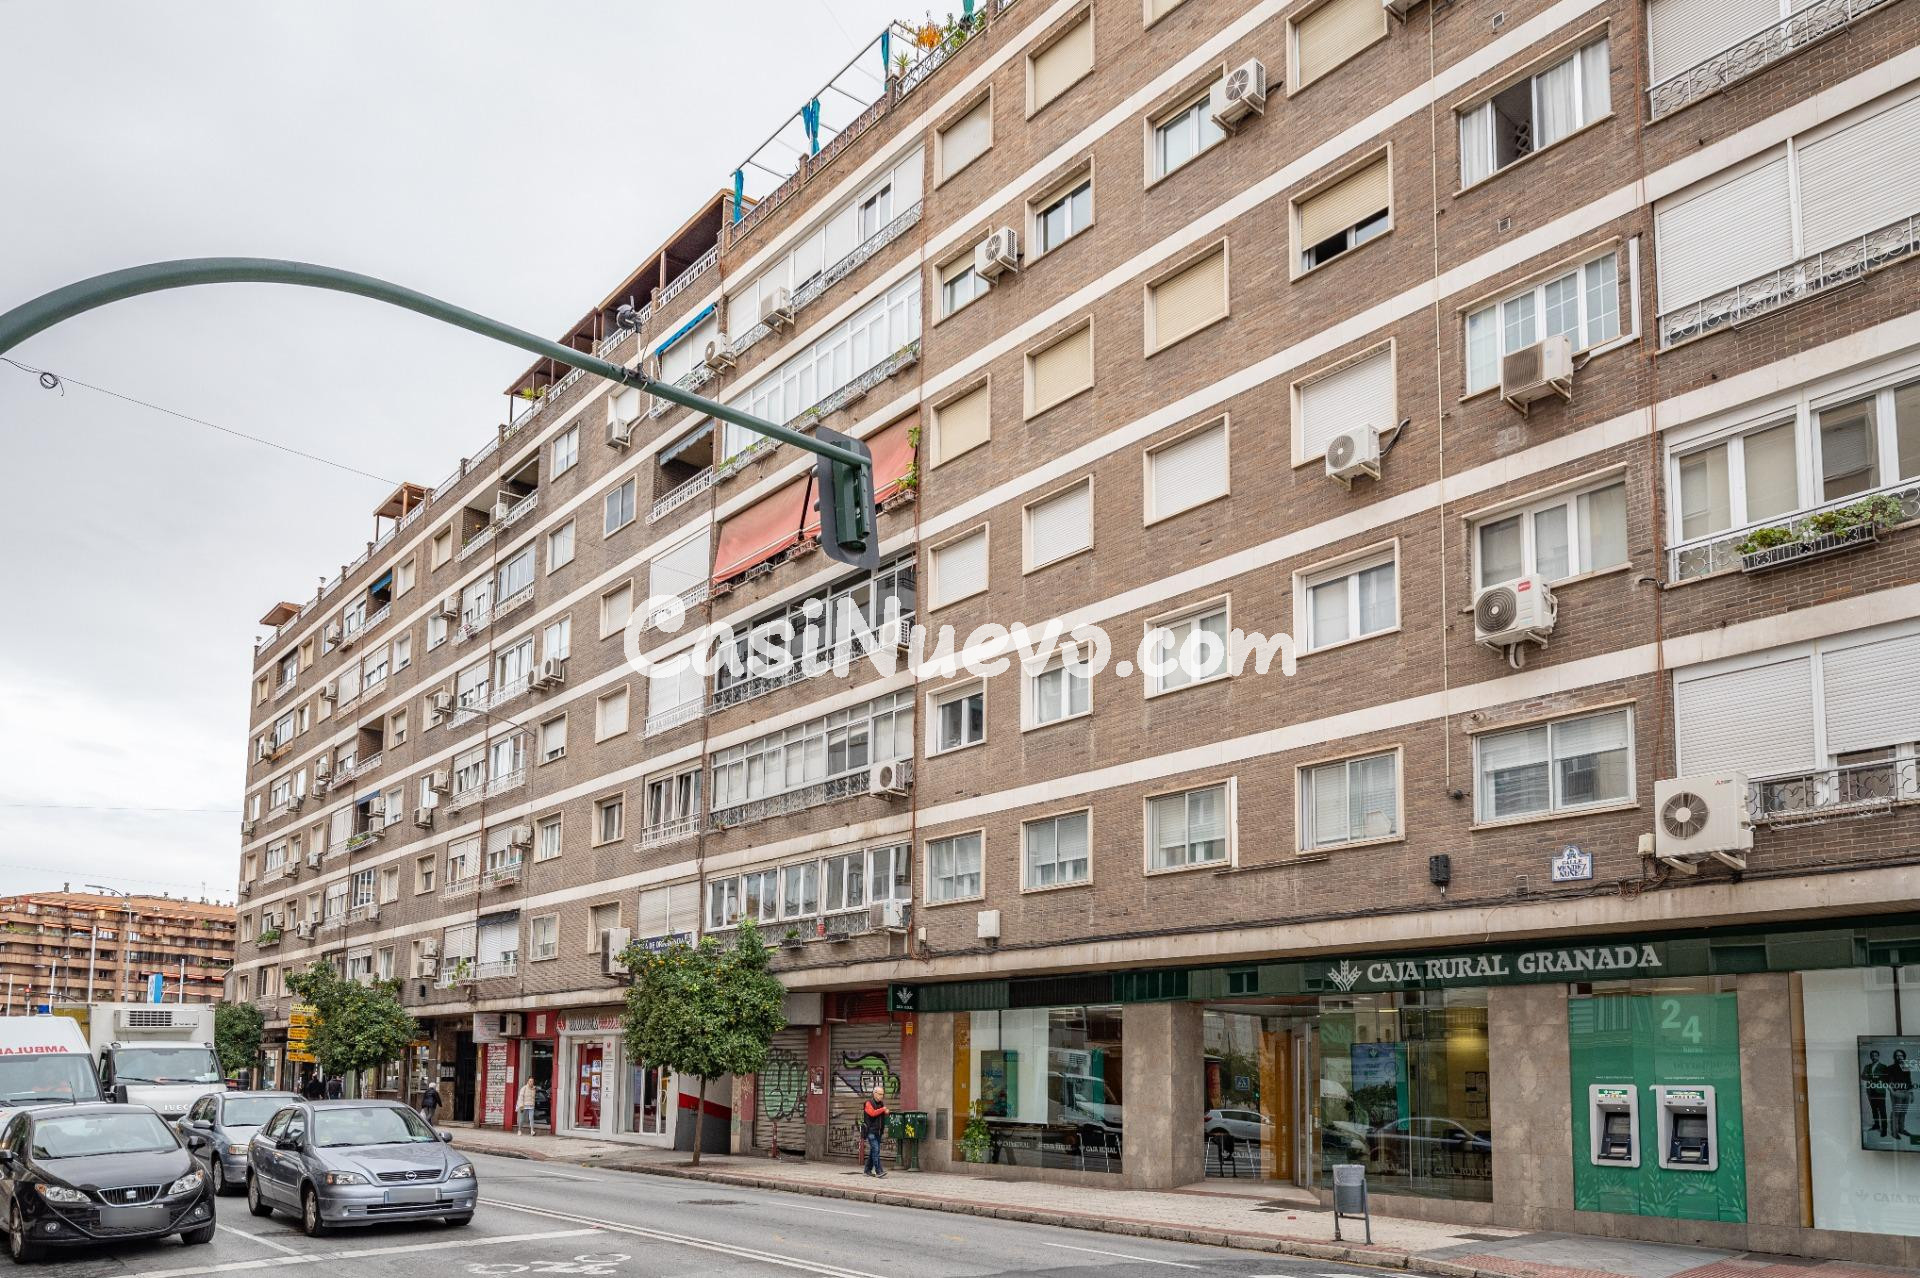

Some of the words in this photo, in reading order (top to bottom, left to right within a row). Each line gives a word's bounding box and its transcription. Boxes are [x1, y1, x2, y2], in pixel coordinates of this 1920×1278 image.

[1367, 961, 1421, 984] CAJA
[1424, 954, 1509, 979] RURAL
[1517, 945, 1662, 974] GRANADA
[1085, 1145, 1099, 1153] CAJA
